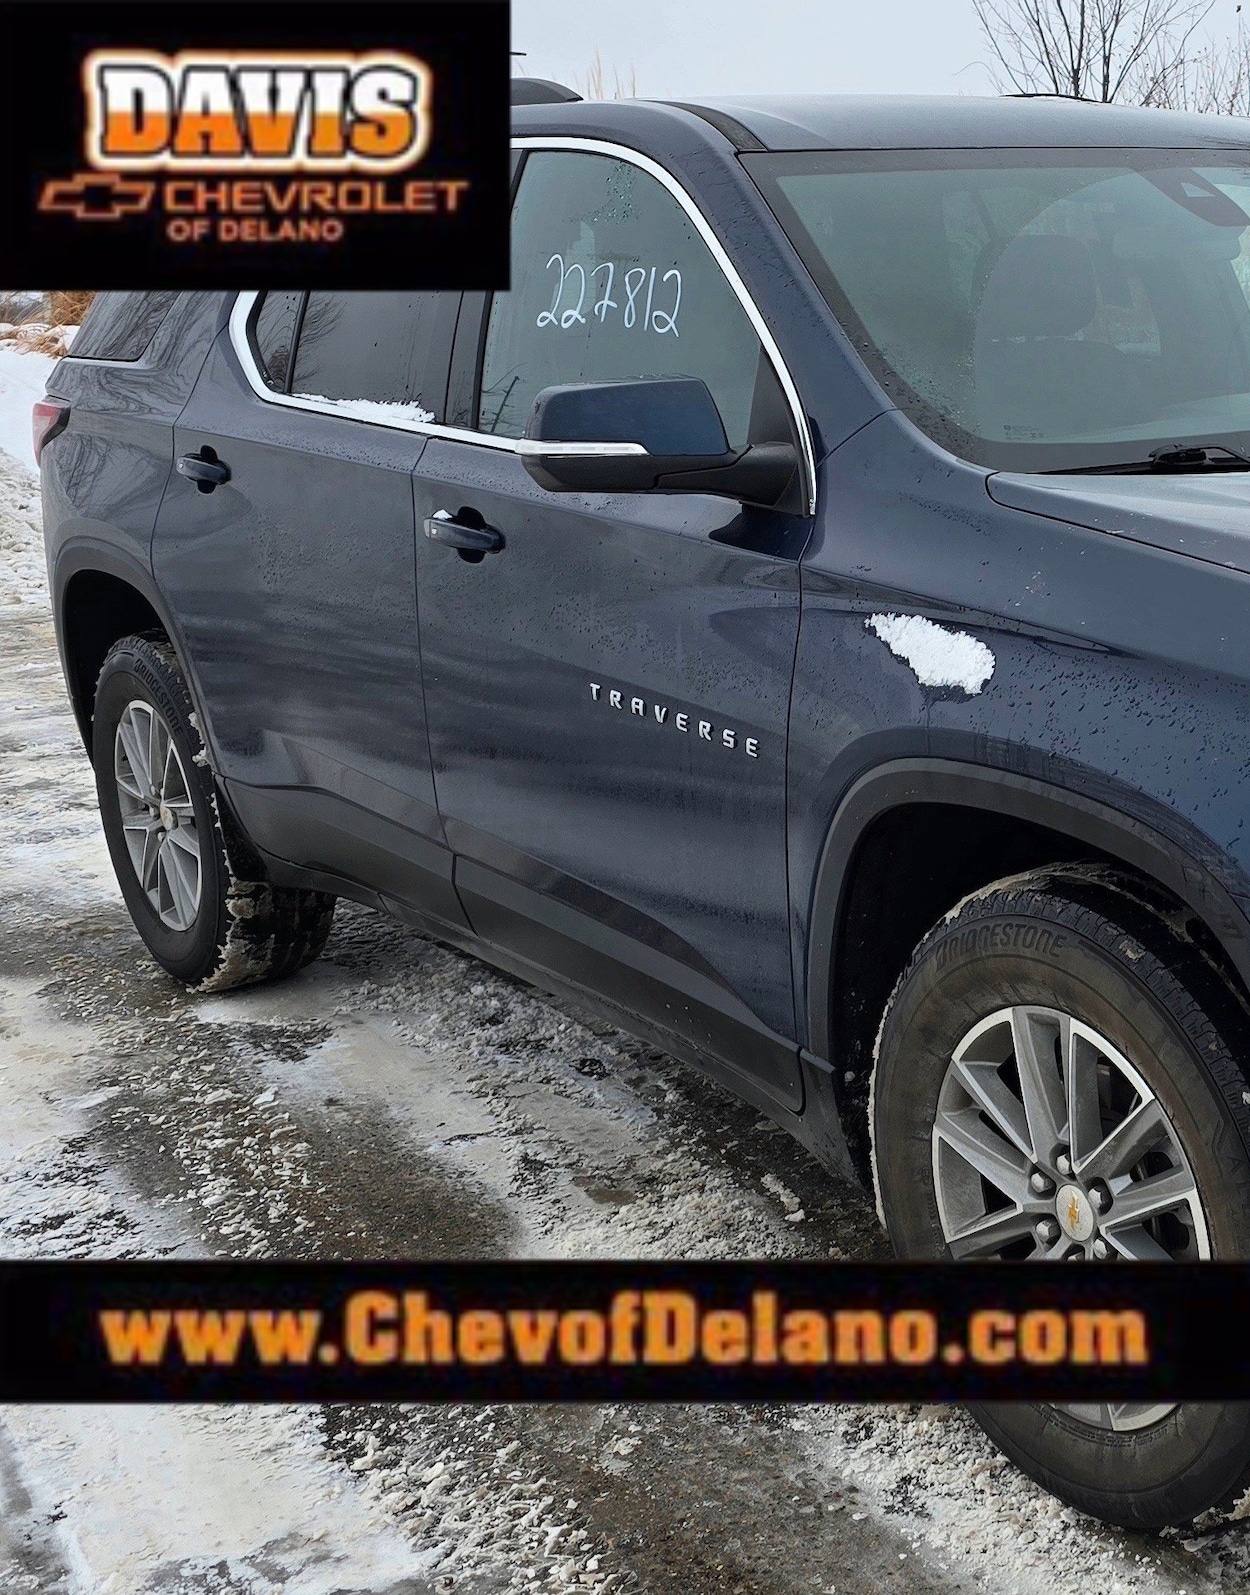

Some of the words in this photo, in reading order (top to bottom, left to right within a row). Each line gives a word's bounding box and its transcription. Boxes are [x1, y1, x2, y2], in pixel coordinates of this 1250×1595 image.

[536, 253, 683, 337] 227812
[588, 681, 760, 759] TRAVERSE
[936, 922, 1068, 971] BRIDGESTONE
